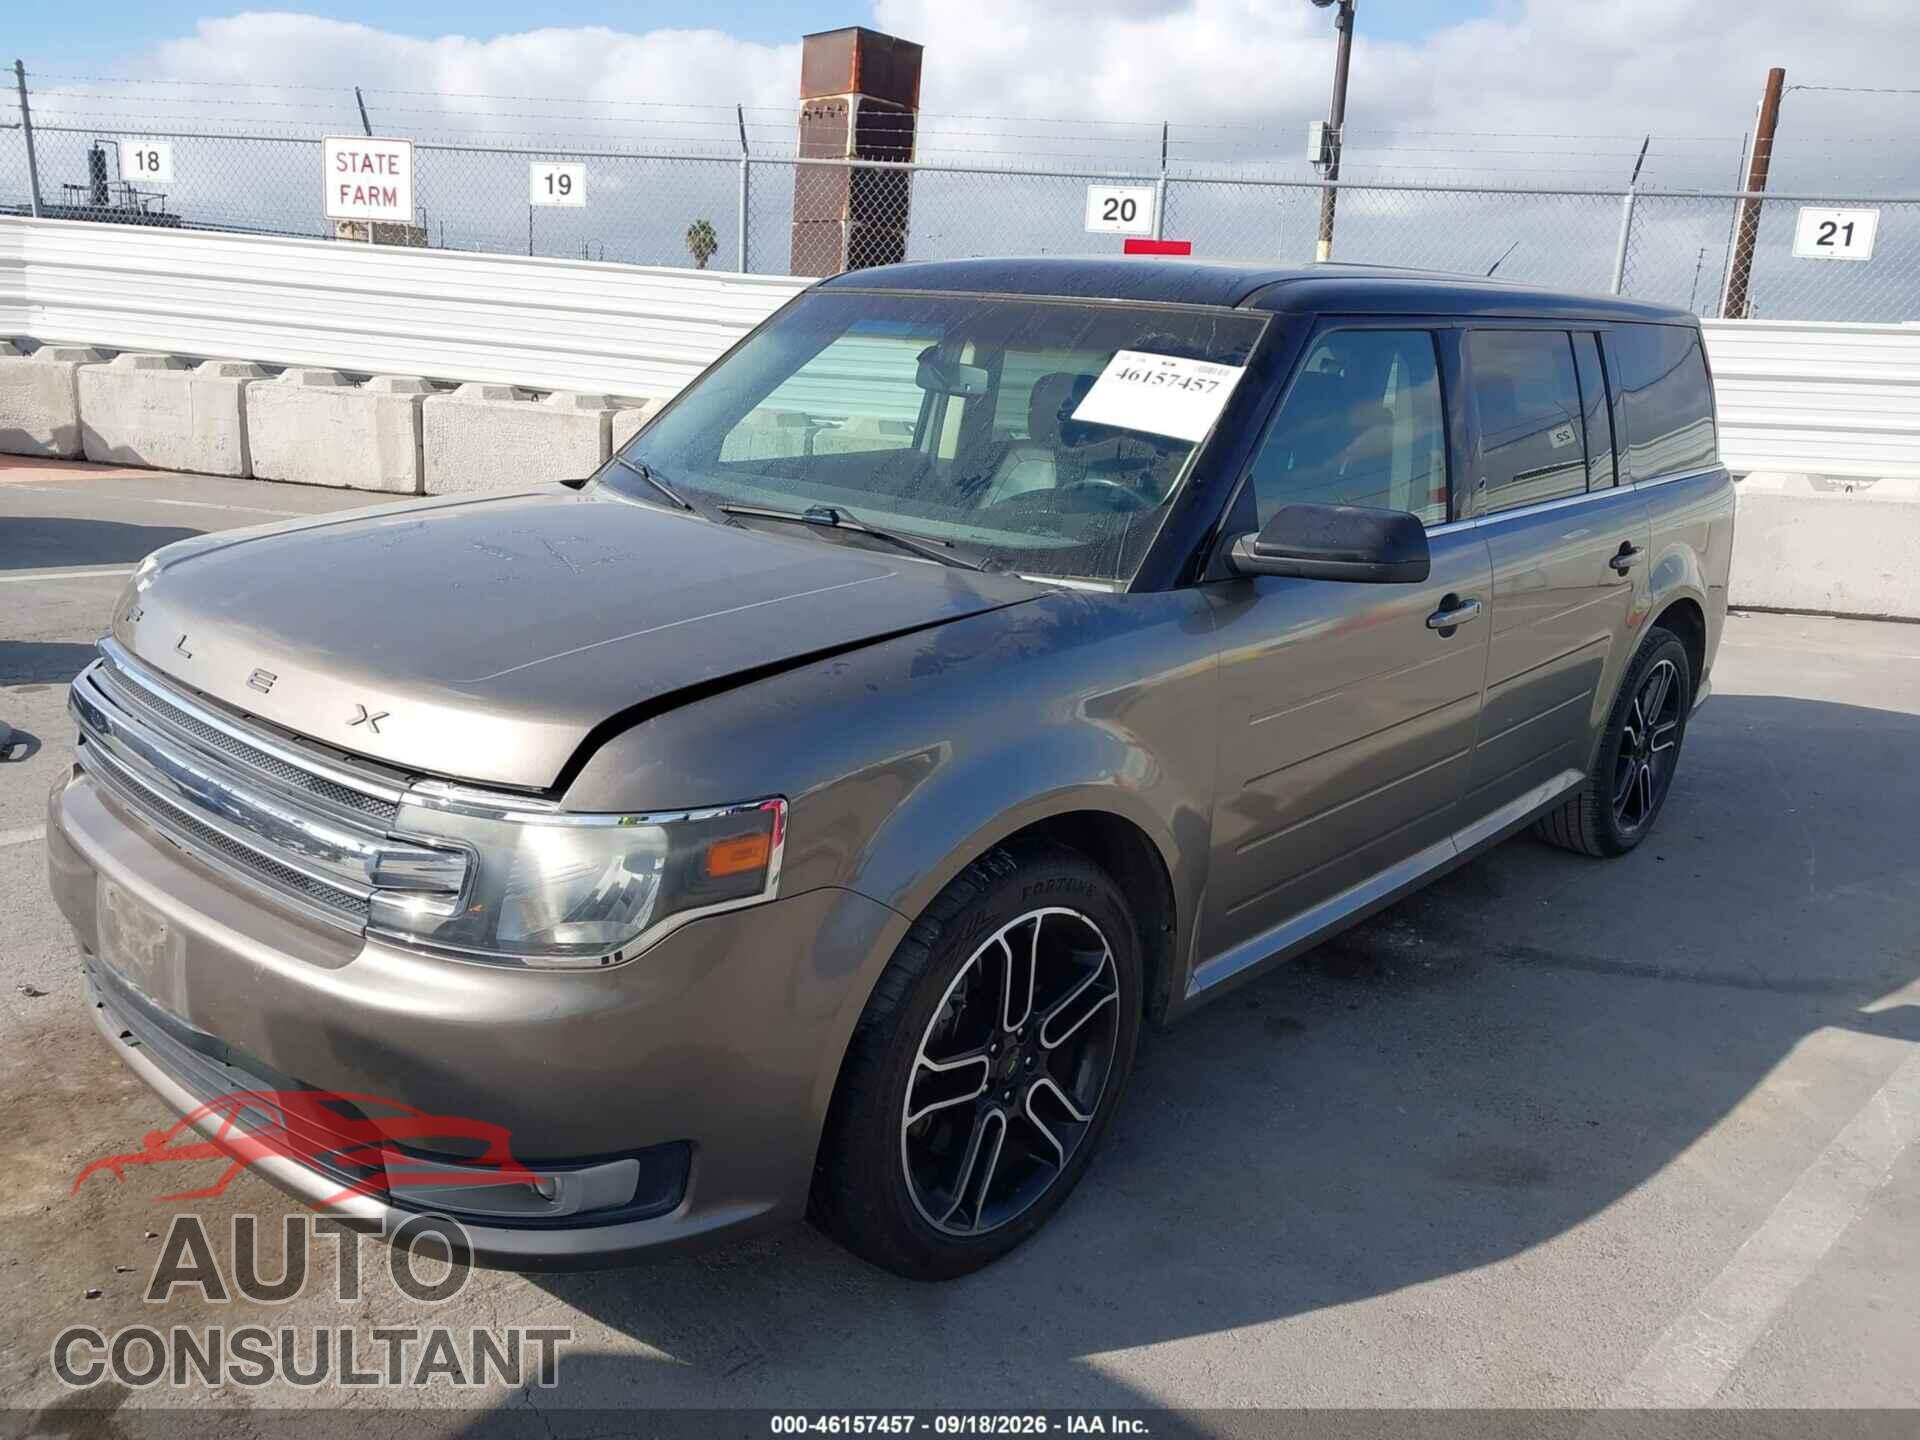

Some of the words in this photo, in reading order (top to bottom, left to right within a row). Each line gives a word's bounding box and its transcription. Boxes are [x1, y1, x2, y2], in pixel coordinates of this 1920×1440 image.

[135, 150, 160, 172] 18
[335, 152, 401, 175] STATE
[544, 173, 572, 196] 19
[339, 185, 398, 208] FARM
[1103, 198, 1137, 223] 20
[1816, 220, 1858, 247] 21
[1116, 367, 1220, 393] 46157457
